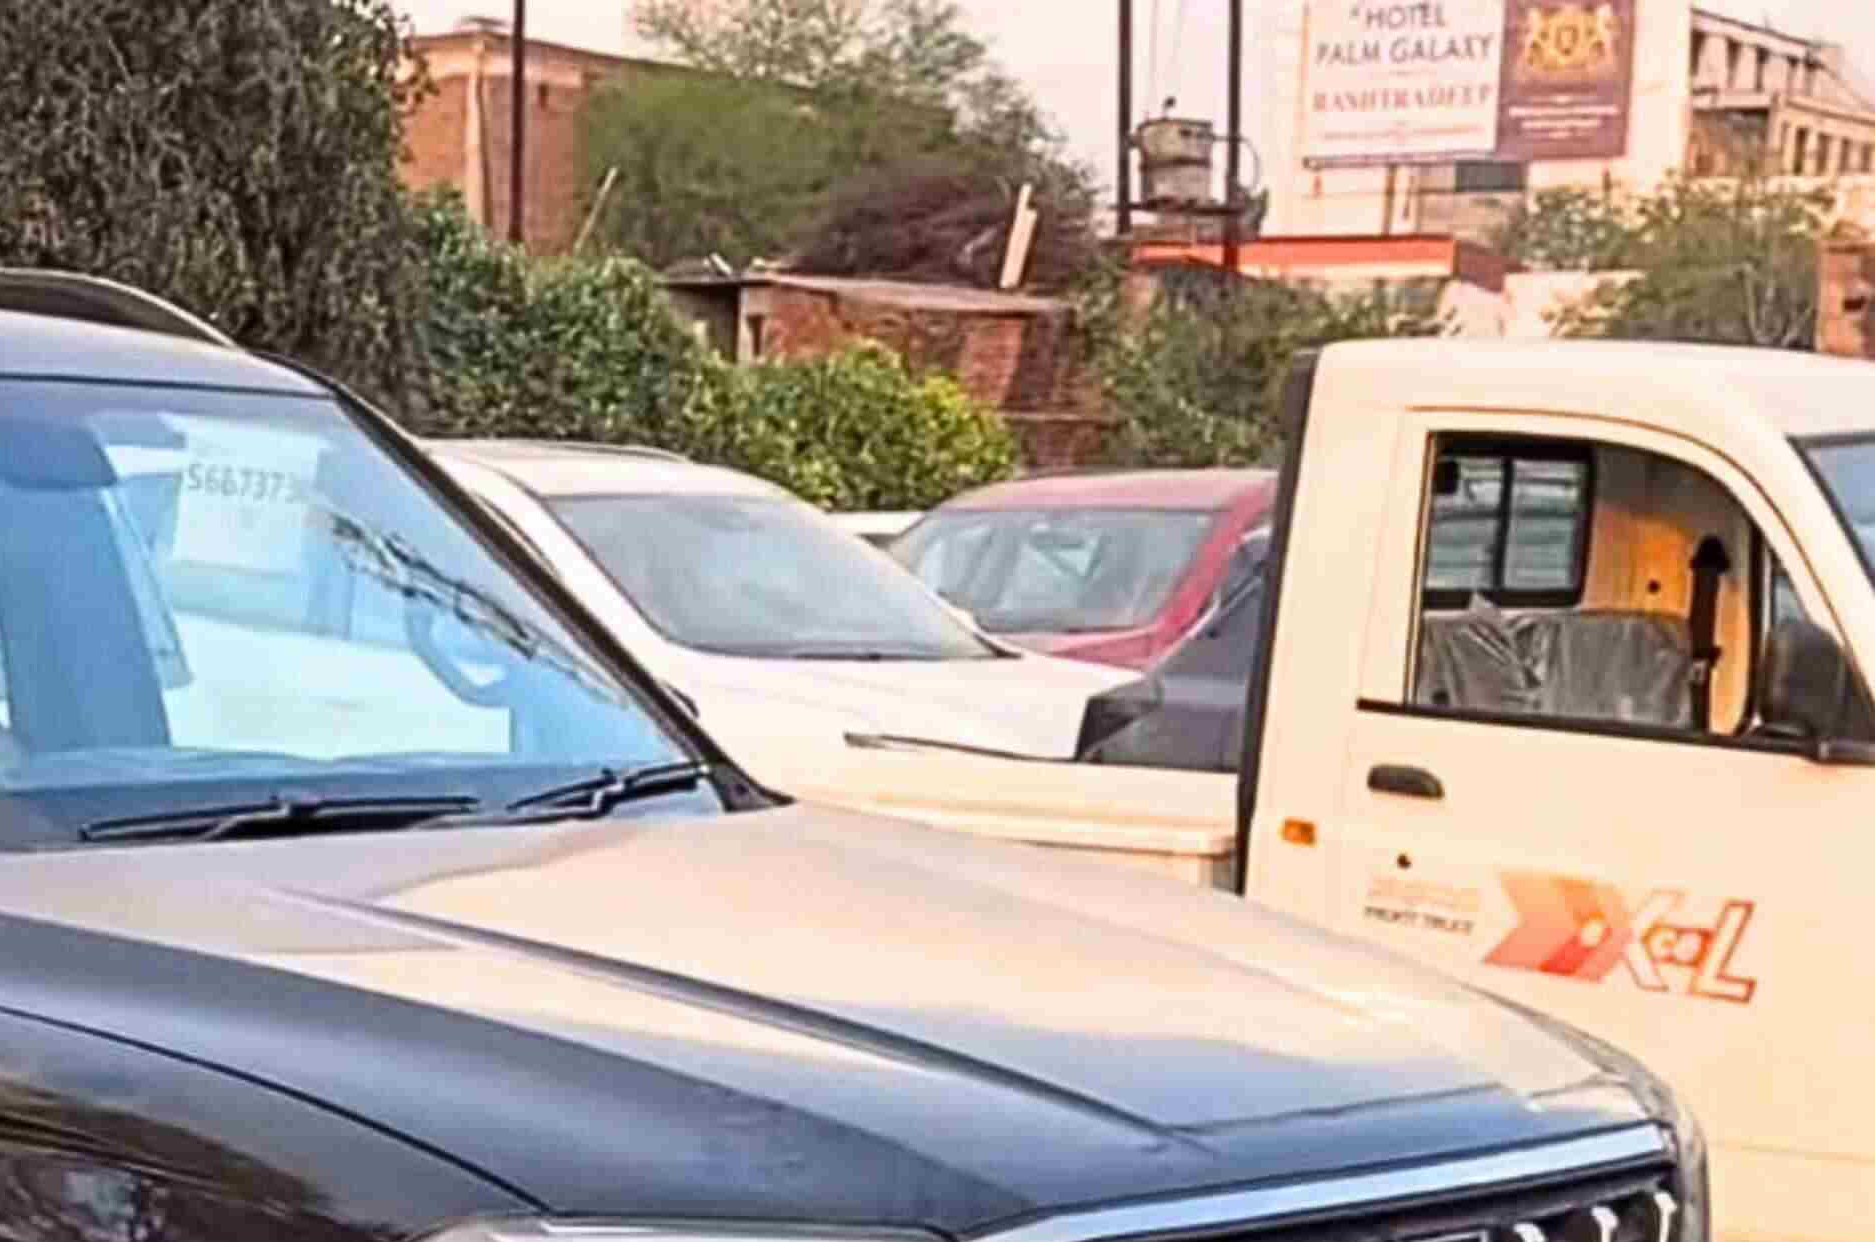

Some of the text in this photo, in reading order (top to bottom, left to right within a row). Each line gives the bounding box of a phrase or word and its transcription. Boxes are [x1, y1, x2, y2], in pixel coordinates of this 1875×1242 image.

[1365, 2, 1447, 29] HOTEL
[1315, 34, 1492, 67] PALM GALAXY
